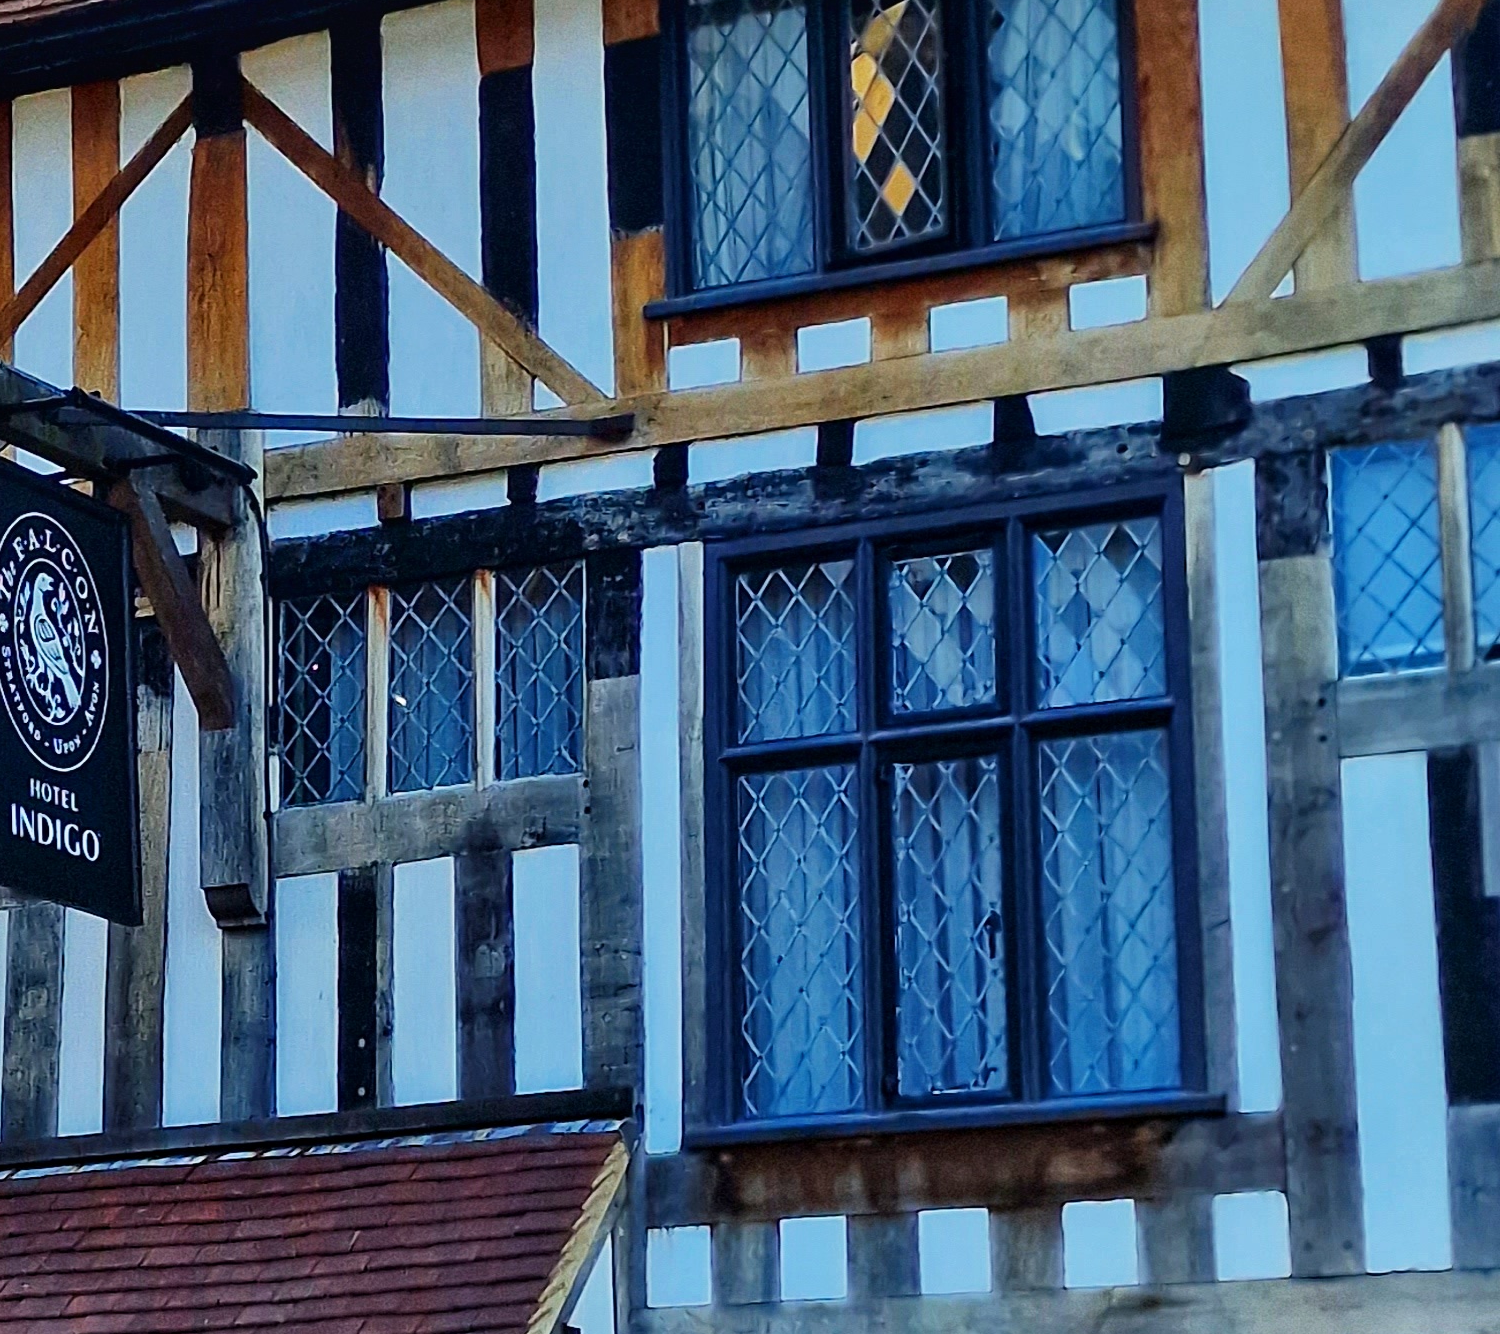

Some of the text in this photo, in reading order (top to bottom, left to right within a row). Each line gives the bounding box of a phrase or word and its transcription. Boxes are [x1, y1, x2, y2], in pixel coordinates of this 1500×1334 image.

[0, 560, 16, 602] The
[29, 777, 80, 813] HOTEL
[11, 802, 100, 862] INDIGO
